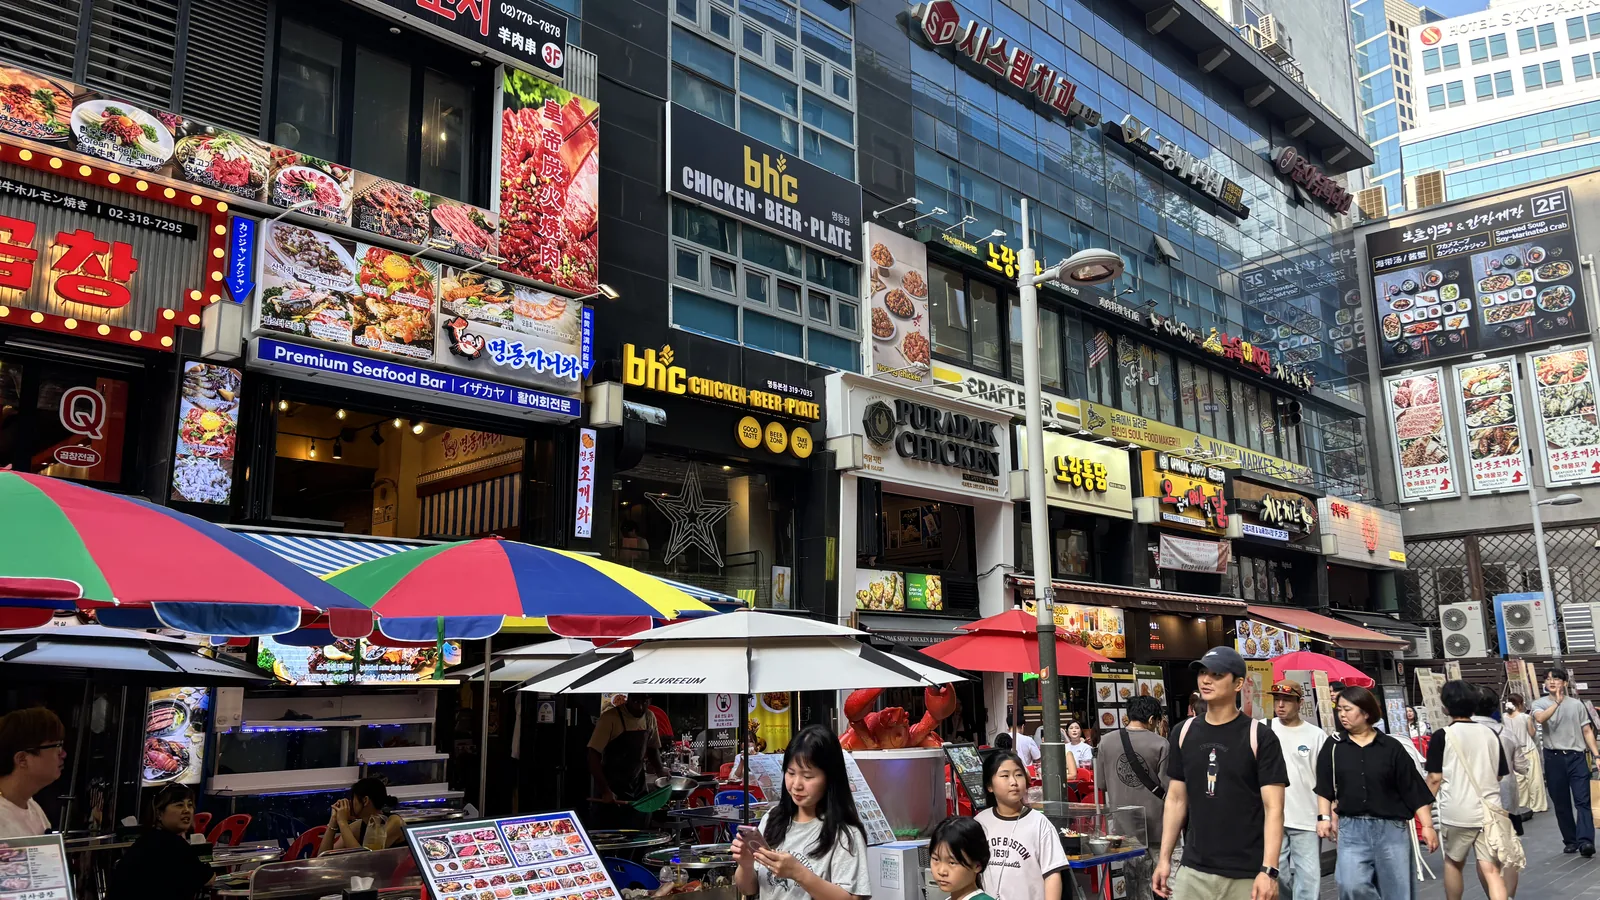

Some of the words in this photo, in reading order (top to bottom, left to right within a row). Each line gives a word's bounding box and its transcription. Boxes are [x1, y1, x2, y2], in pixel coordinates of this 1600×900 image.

[500, 3, 562, 38] 02)778-7878
[1449, 16, 1498, 37] HOTEL
[498, 26, 537, 56] 羊肉串
[544, 45, 562, 67] 3F
[956, 19, 1077, 116] 시스템치과
[79, 125, 118, 143] 한우육회
[77, 134, 111, 148] Korean
[112, 143, 133, 156] Beef
[133, 149, 166, 165] Tartare
[744, 145, 799, 204] bhc
[1536, 197, 1562, 214] 2F
[108, 207, 184, 235] 02-318-7295
[832, 211, 851, 226] 명동점
[1456, 222, 1465, 231] &
[1465, 204, 1525, 230] 간장게장
[1495, 224, 1527, 238] Seaweed
[1527, 220, 1546, 231] Soup
[1495, 226, 1549, 244] Soy-Marinated
[1550, 222, 1568, 232] Crab
[1436, 237, 1471, 251] ワカメスープ
[1436, 241, 1487, 257] カンジャンケジャン
[235, 221, 249, 295] カンジャンケジャン
[488, 339, 582, 380] 명동가니와
[623, 343, 687, 395] bhc
[274, 344, 349, 373] Premium
[352, 360, 417, 387] Seafood
[420, 373, 447, 391] Bar
[460, 381, 505, 400] イザカヤ
[517, 391, 571, 413] 활어회전문
[788, 385, 813, 398] 319-7033
[966, 377, 1015, 407] CRAFT
[59, 386, 106, 439] Q
[894, 398, 999, 447] PURADAK
[743, 425, 758, 434] GOOD
[743, 431, 758, 441] TASTE
[769, 430, 783, 439] BEER
[796, 436, 808, 444] TAKE
[1111, 425, 1127, 438] 당신의
[1128, 429, 1143, 441] SOUL
[1144, 432, 1158, 444] FOOD
[769, 437, 783, 445] ZONE
[59, 450, 96, 463] 곱창전골
[579, 451, 595, 462] 명동
[895, 430, 1000, 477] CHICKEN
[1209, 441, 1223, 461] NY
[1224, 444, 1238, 458] NIGHT
[1239, 450, 1273, 476] MARKET
[1551, 447, 1600, 462] 명동조개와
[1055, 455, 1108, 493] 노랑통닭
[1404, 466, 1449, 480] 명동조개와
[1474, 458, 1522, 471] 명동조개와
[577, 465, 592, 524] 조개와
[648, 677, 707, 685] LIVREEUM
[991, 837, 1002, 847] OF
